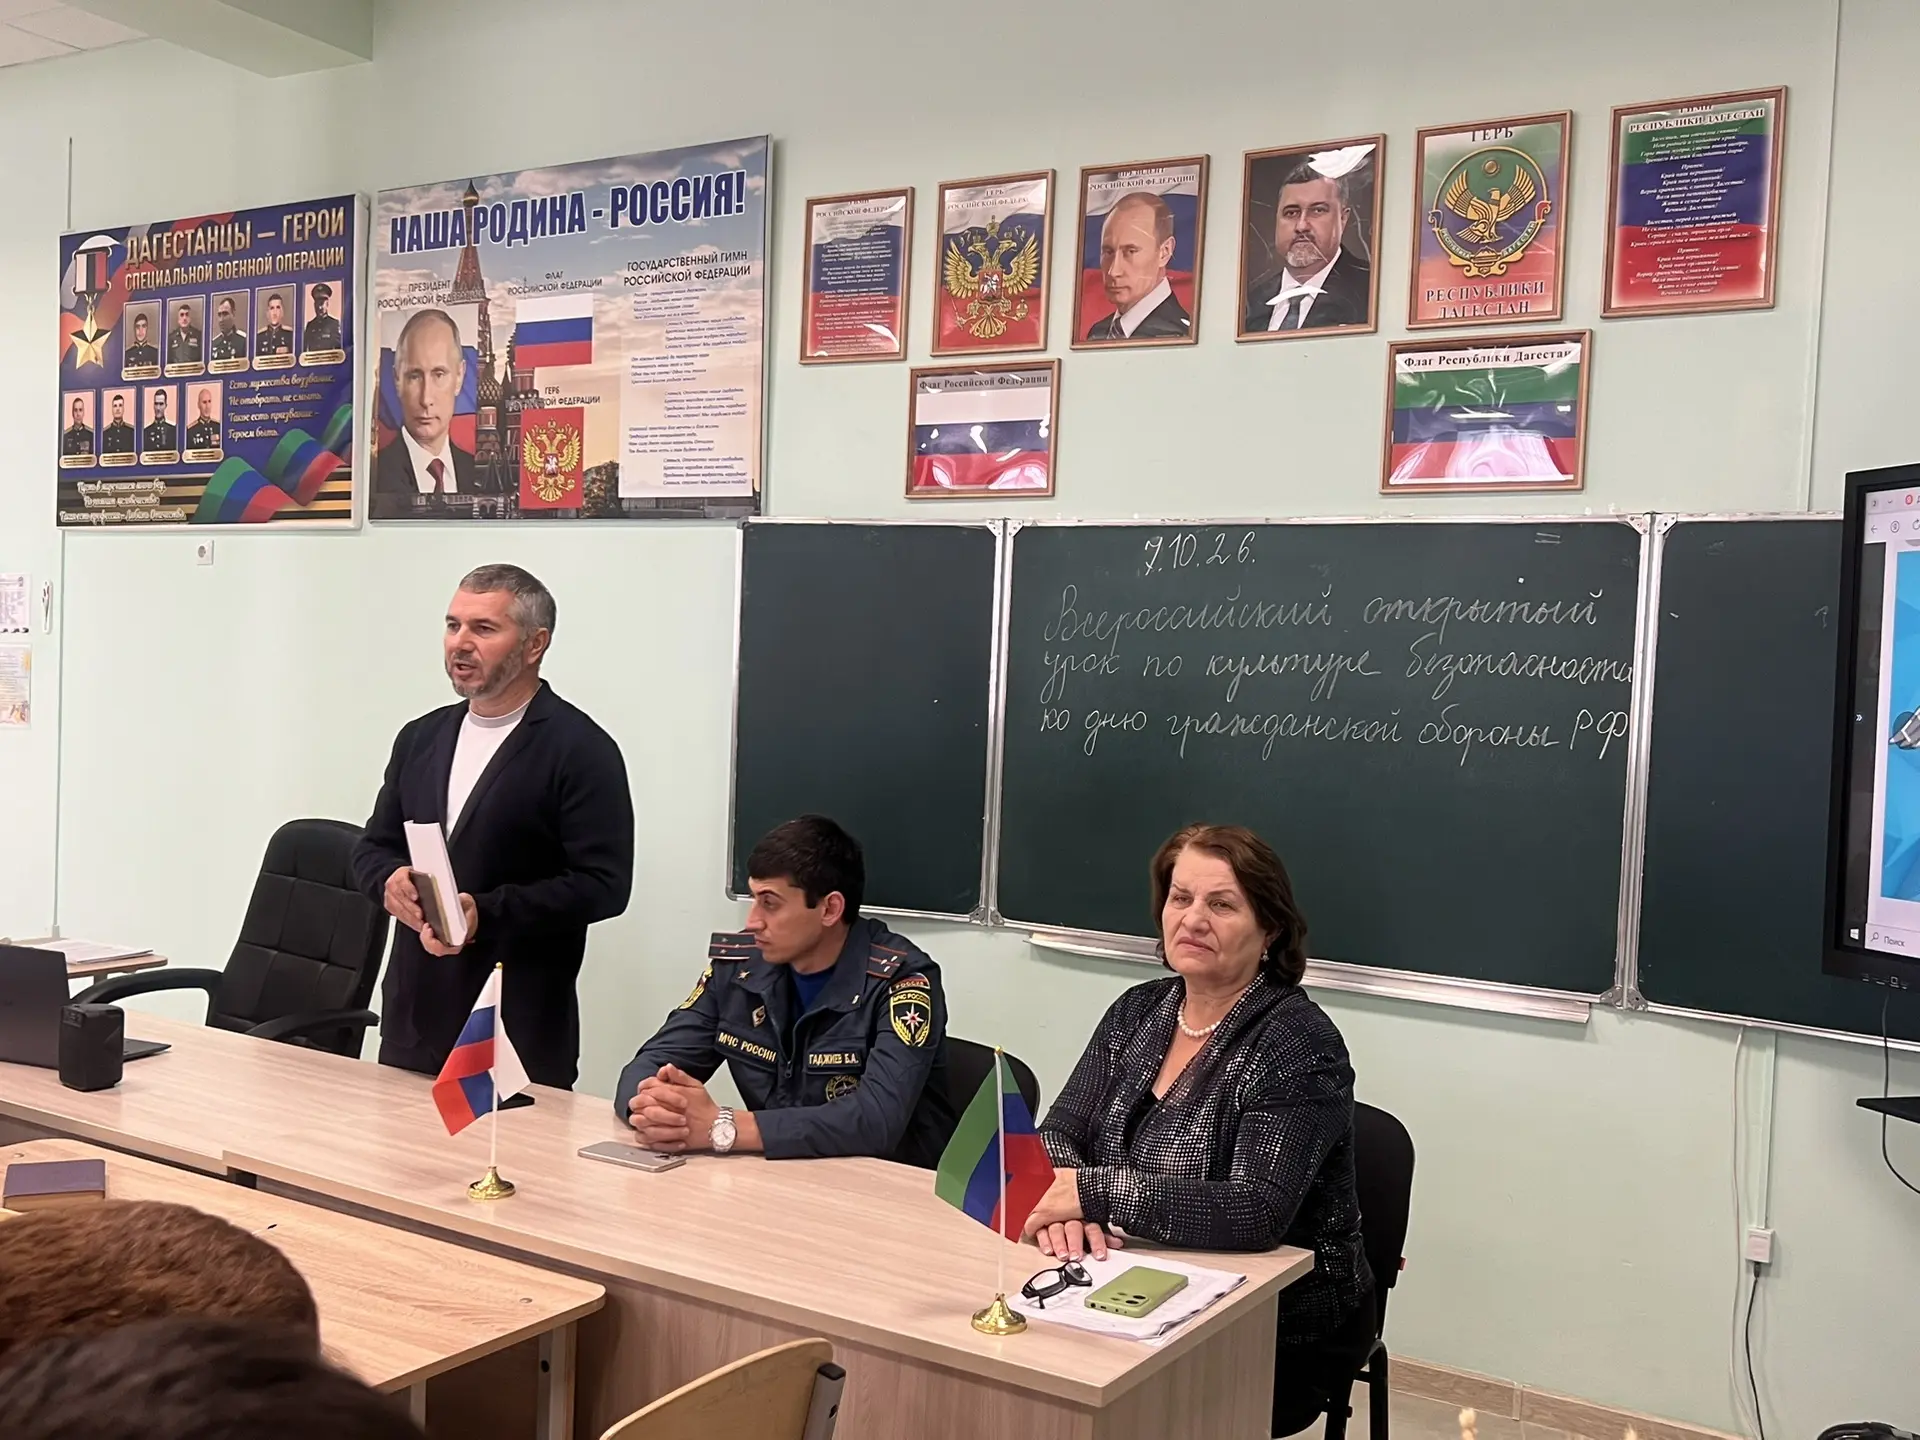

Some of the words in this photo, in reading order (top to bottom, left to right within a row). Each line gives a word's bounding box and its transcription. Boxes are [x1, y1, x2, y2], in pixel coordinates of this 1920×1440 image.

[1628, 116, 1703, 133] РЕСПУБЛИКИ
[1704, 108, 1765, 124] ДАГЕСТАН
[1088, 179, 1144, 190] РОССИЙСКОЙ
[1145, 175, 1195, 186] ФЕДЕРАЦИИ
[390, 208, 467, 255] НАША
[472, 190, 587, 249] РОДИНА
[610, 170, 746, 230] РОССИЯ!
[125, 220, 251, 270] ДАГЕСТАНЦЫ
[282, 206, 345, 244] ГЕРОИ
[125, 261, 213, 292] СПЕЦИАЛЬНОЙ
[217, 253, 273, 281] ВОЕННОЙ
[276, 246, 344, 274] ОПЕРАЦИИ
[627, 251, 718, 272] ГОСУДАРСТВЕННЫЙ
[720, 250, 748, 263] ГИМН
[545, 271, 563, 280] ФЛАГ
[624, 268, 692, 287] РОССИЙСКОЙ
[694, 265, 751, 281] ФЕДЕРАЦИИ
[408, 280, 451, 292] ПРЕЗИДЕНТ
[507, 282, 559, 296] РОССИЙСКОЙ
[560, 278, 602, 290] ФЕДЕРАЦИИ
[1426, 281, 1545, 303] РЕСПУБЛИКИ
[377, 293, 434, 308] РОССИЙСКОЙ
[1438, 301, 1530, 319] ДАГЕСТАН
[1404, 357, 1433, 367] Флаг
[1438, 352, 1510, 367] Республики
[544, 386, 560, 395] ГЕРБ
[944, 377, 995, 388] Российской
[558, 396, 600, 406] ФЕДЕРАЦИИ
[1043, 584, 1332, 656] Всероссийский
[1363, 588, 1603, 645] открытый
[1040, 651, 1121, 704] урок
[1142, 655, 1183, 677] по
[1205, 650, 1382, 702] культуре
[1040, 708, 1071, 732] ко
[1083, 709, 1148, 756] дню
[1165, 708, 1403, 761] гражданской
[1418, 703, 1560, 766] обороны
[1569, 708, 1629, 760] РФ
[1883, 935, 1906, 948] Поиск
[718, 1031, 739, 1047] МЧС
[740, 1040, 777, 1062] РОССИИ
[808, 1053, 842, 1066] ГАДЖИЕВ
